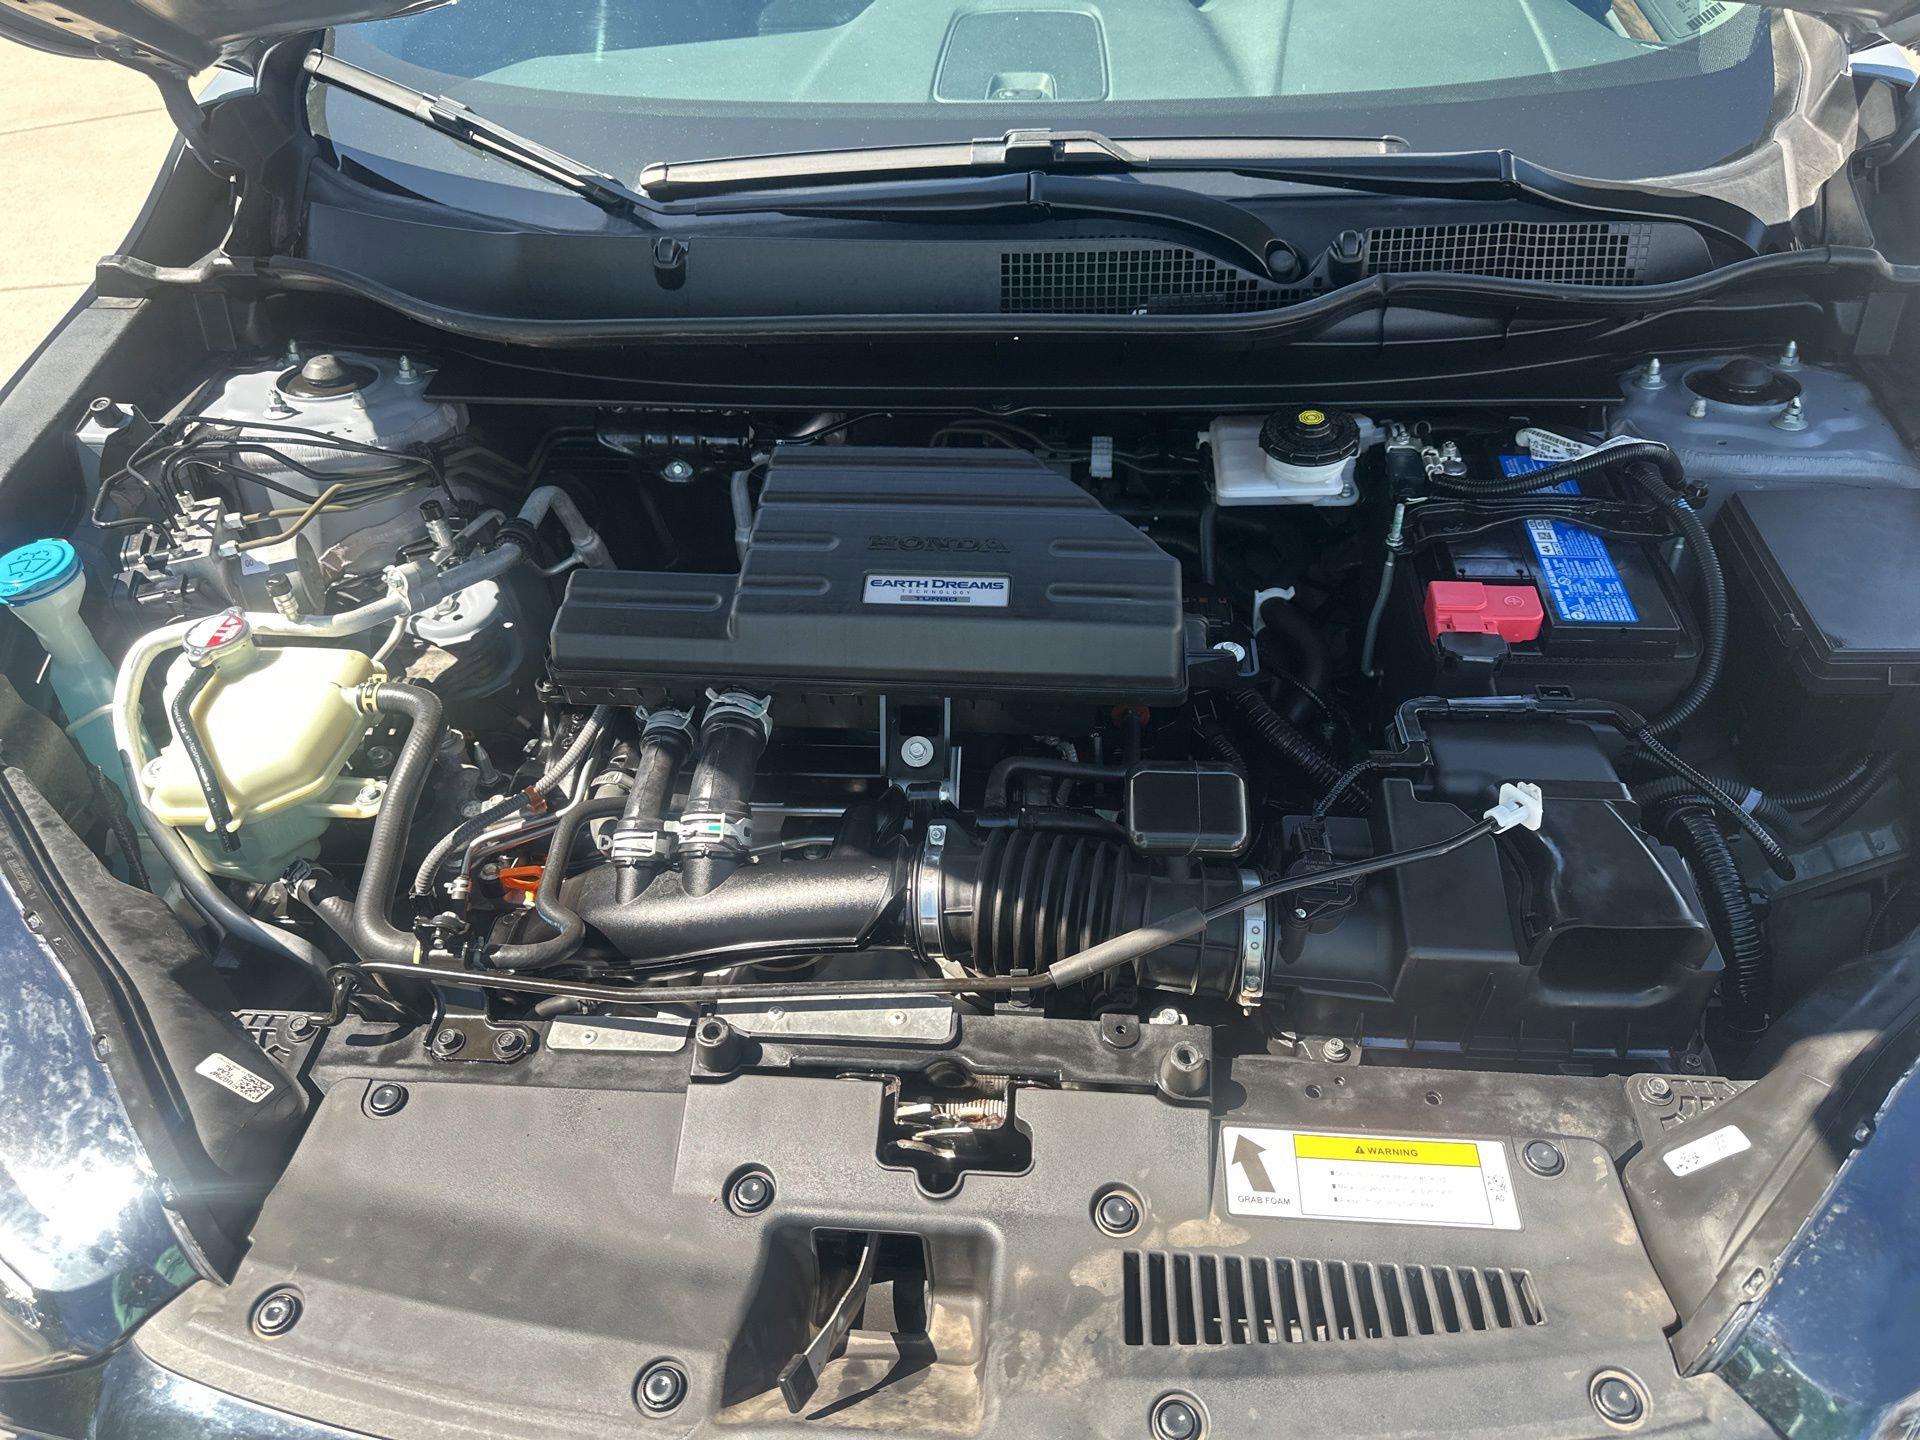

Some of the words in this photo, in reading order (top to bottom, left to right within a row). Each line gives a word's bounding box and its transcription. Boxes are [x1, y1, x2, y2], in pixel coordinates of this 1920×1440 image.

[868, 535, 1011, 553] HONDA
[870, 579, 928, 588] EARTH
[932, 579, 1004, 590] DREAMS
[1367, 1146, 1419, 1157] WARNING
[1237, 1194, 1263, 1205] GRAB
[1265, 1195, 1291, 1206] FOAM
